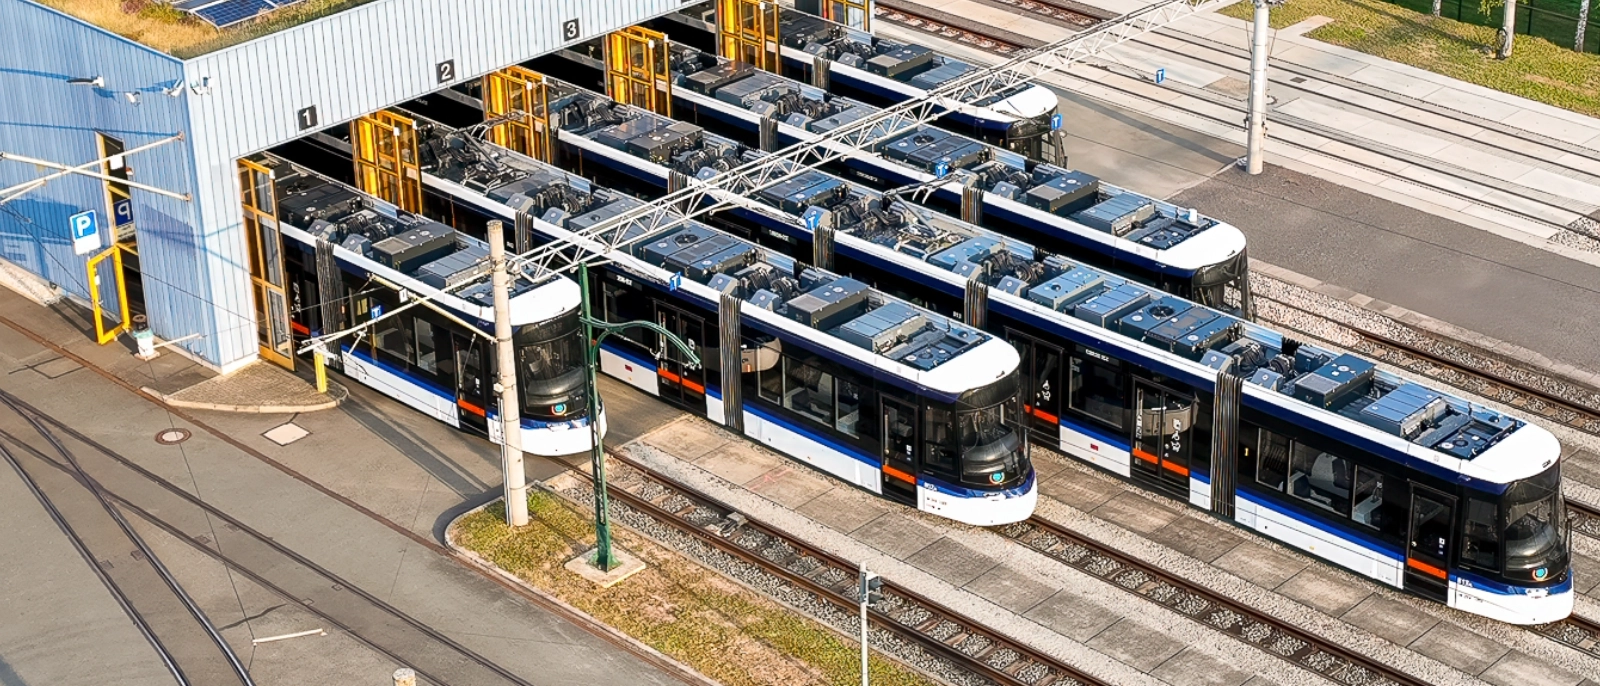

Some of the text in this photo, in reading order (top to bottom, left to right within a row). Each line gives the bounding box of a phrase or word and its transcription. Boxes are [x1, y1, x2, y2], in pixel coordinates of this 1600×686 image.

[567, 21, 577, 38] 3
[440, 63, 451, 80] 2
[302, 110, 311, 126] 1
[1052, 116, 1060, 128] T
[76, 215, 91, 237] P
